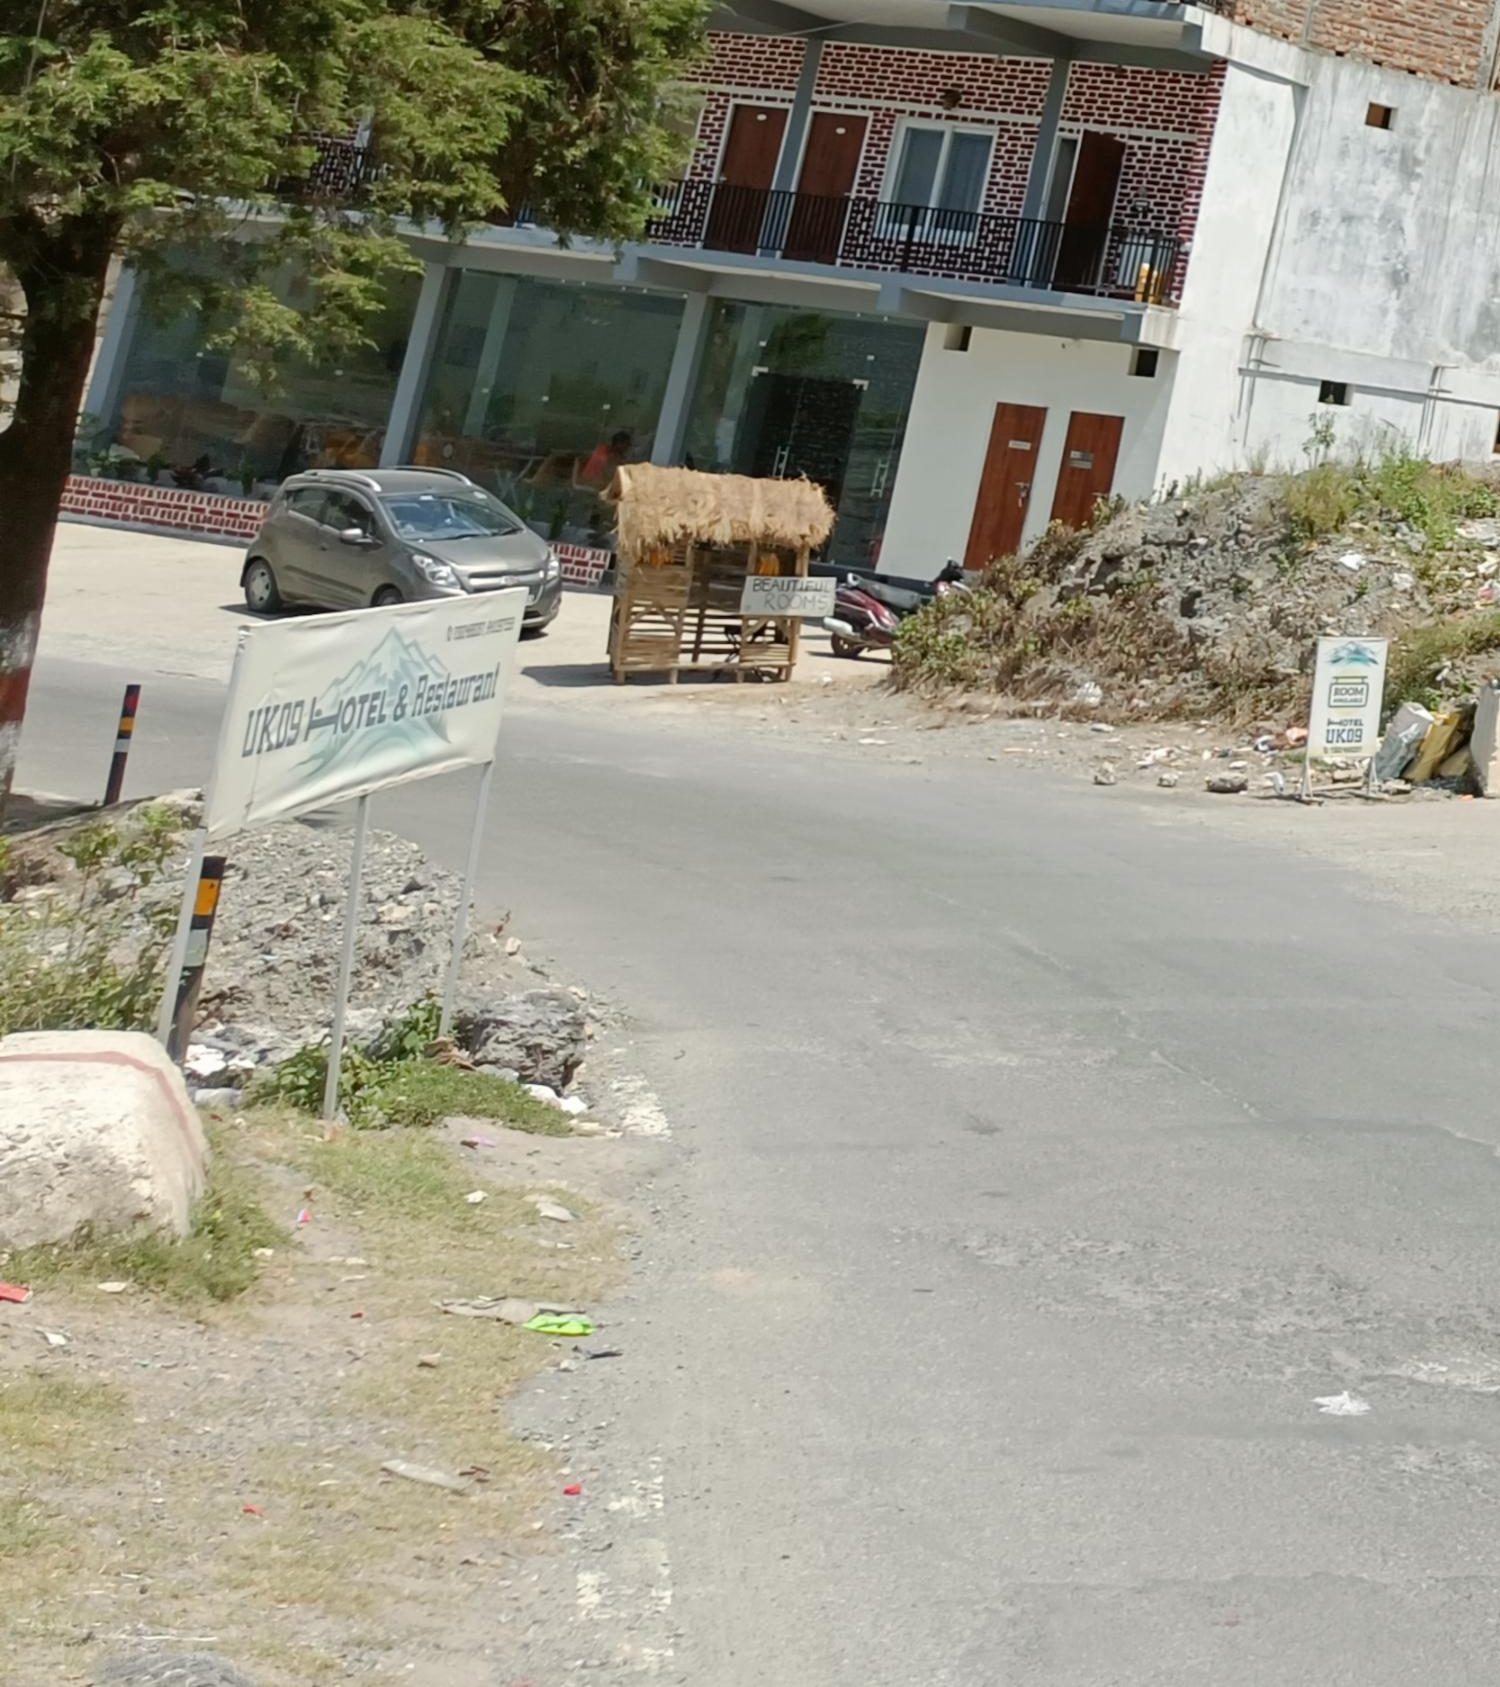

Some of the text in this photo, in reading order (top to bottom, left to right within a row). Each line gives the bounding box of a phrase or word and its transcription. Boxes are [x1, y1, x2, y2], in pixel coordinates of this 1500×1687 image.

[763, 593, 827, 611] ROOMS
[392, 684, 409, 723] &
[411, 662, 500, 718] Restaurant
[1333, 687, 1365, 697] ROOM
[1325, 727, 1363, 744] UK09
